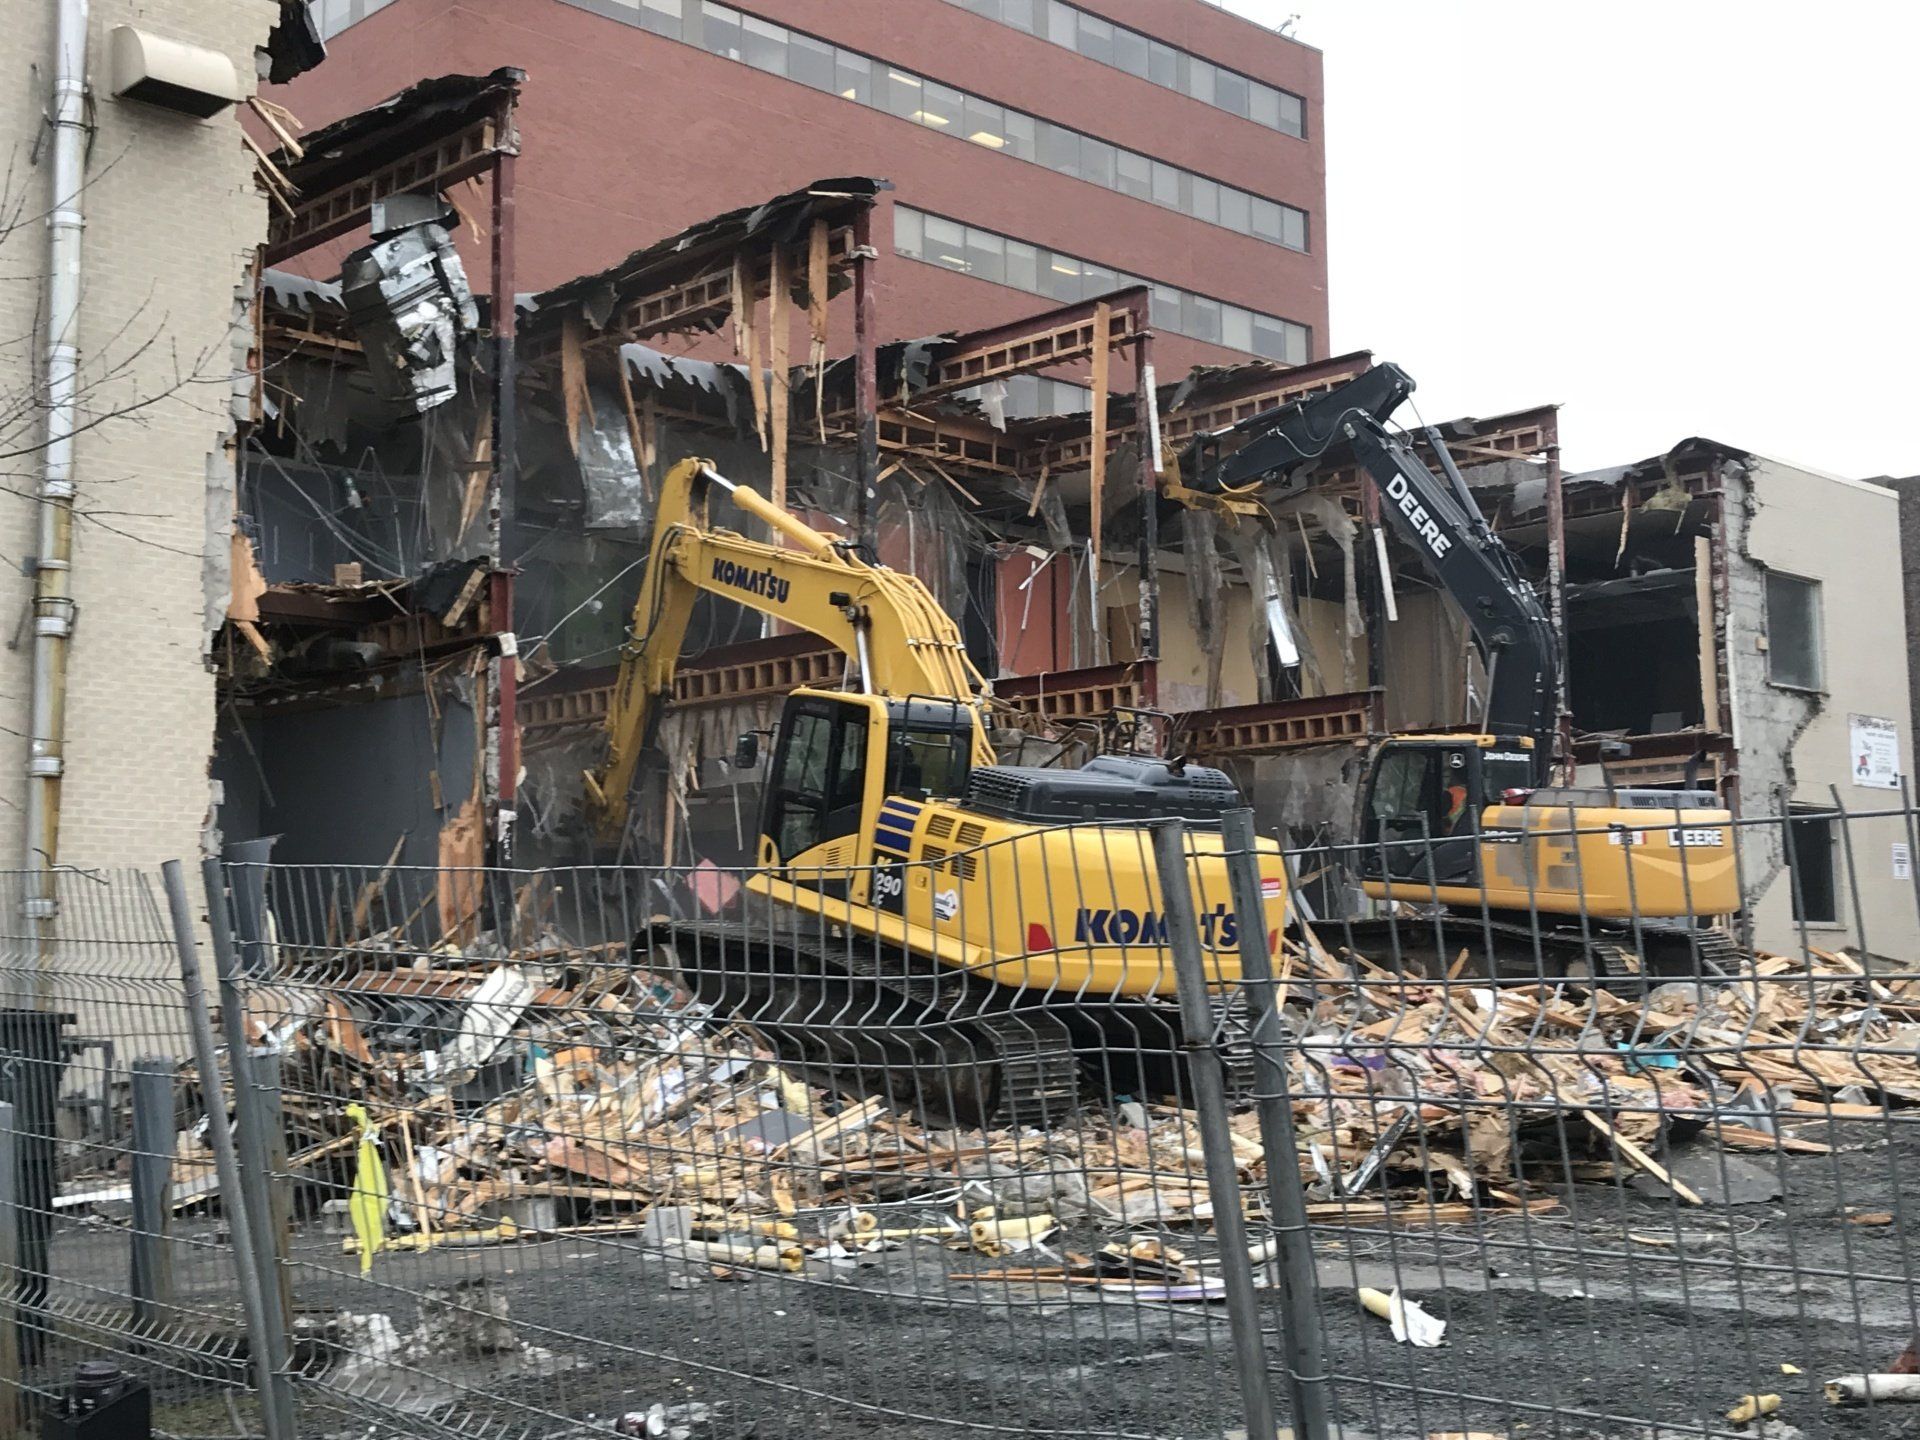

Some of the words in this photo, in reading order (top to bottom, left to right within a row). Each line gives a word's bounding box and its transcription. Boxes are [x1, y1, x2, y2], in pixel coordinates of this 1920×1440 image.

[1386, 472, 1453, 559] DEERE
[712, 557, 791, 604] KOMATSU
[1483, 751, 1503, 760] JOHN
[1504, 751, 1531, 761] DEERE
[1668, 828, 1724, 847] DEERE
[875, 872, 902, 896] 290
[1074, 903, 1239, 947] KOMTS
